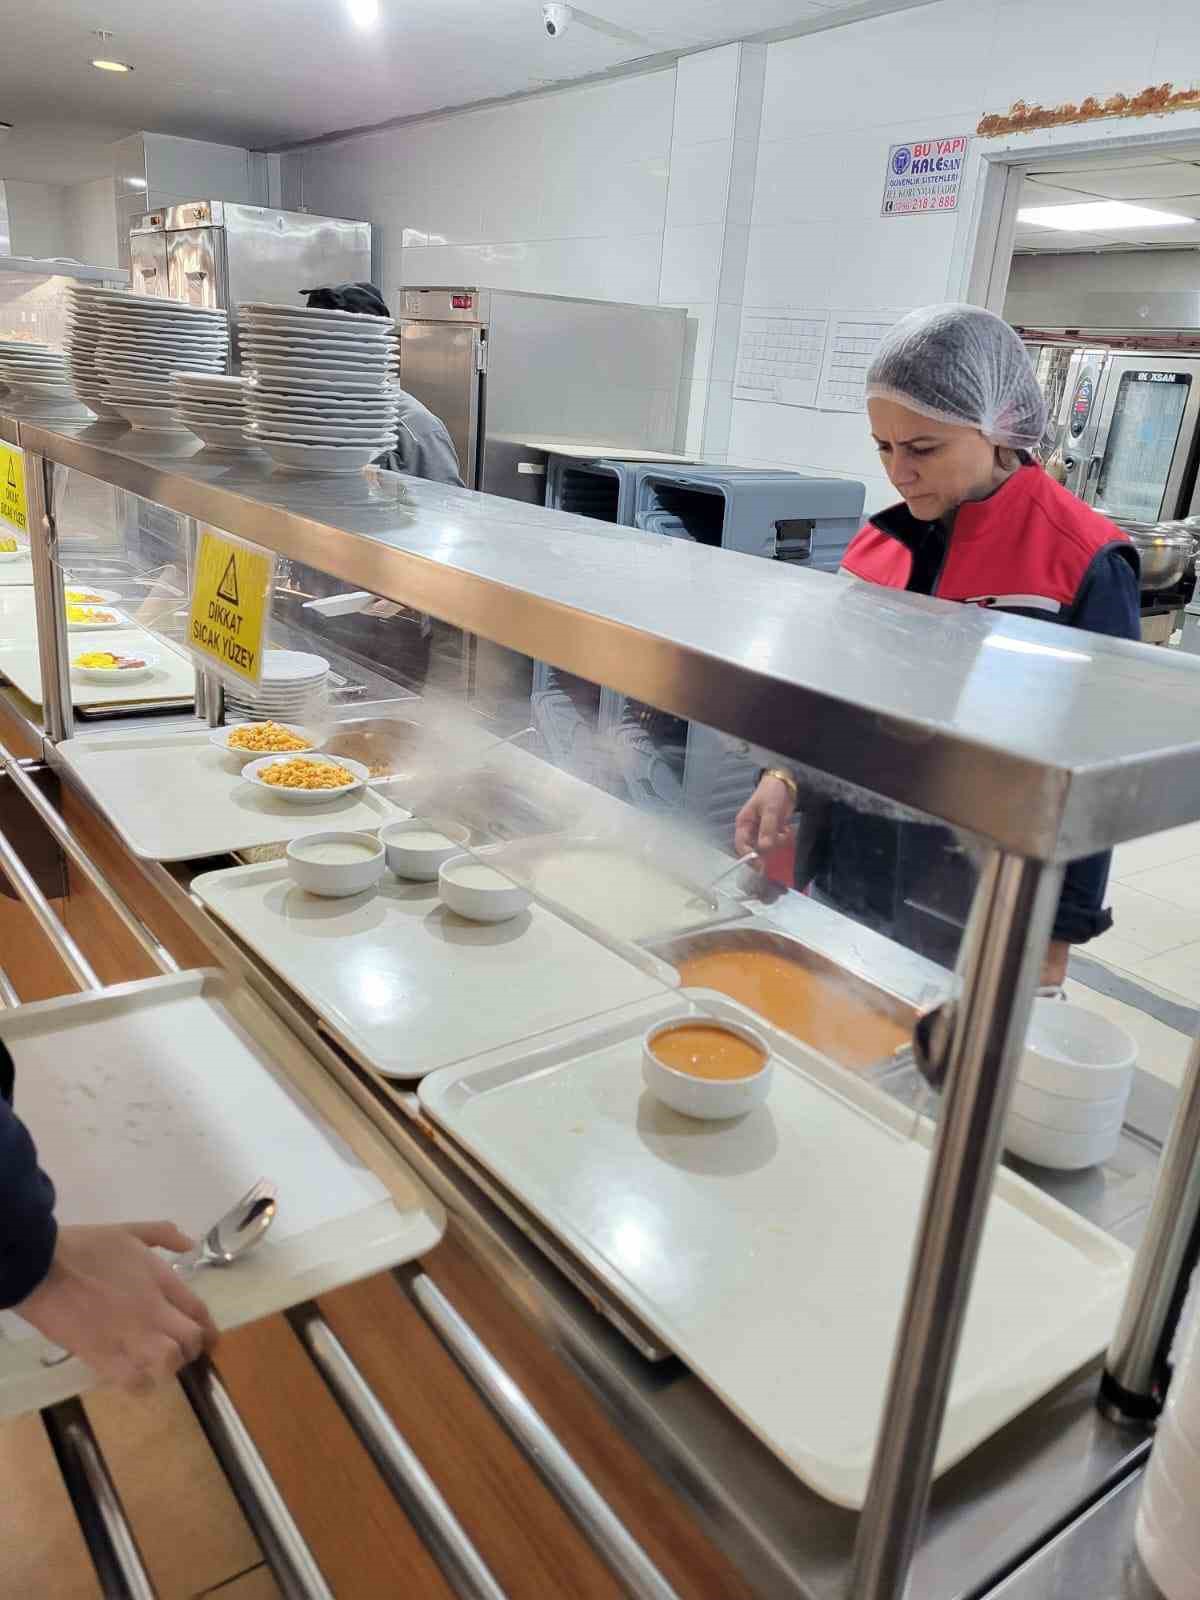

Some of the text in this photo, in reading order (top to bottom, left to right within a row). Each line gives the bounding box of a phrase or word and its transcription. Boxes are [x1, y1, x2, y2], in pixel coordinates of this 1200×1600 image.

[914, 139, 964, 157] BU YAPI
[208, 599, 243, 634] DİKKAT
[193, 619, 254, 672] SICAK YÜZEY
